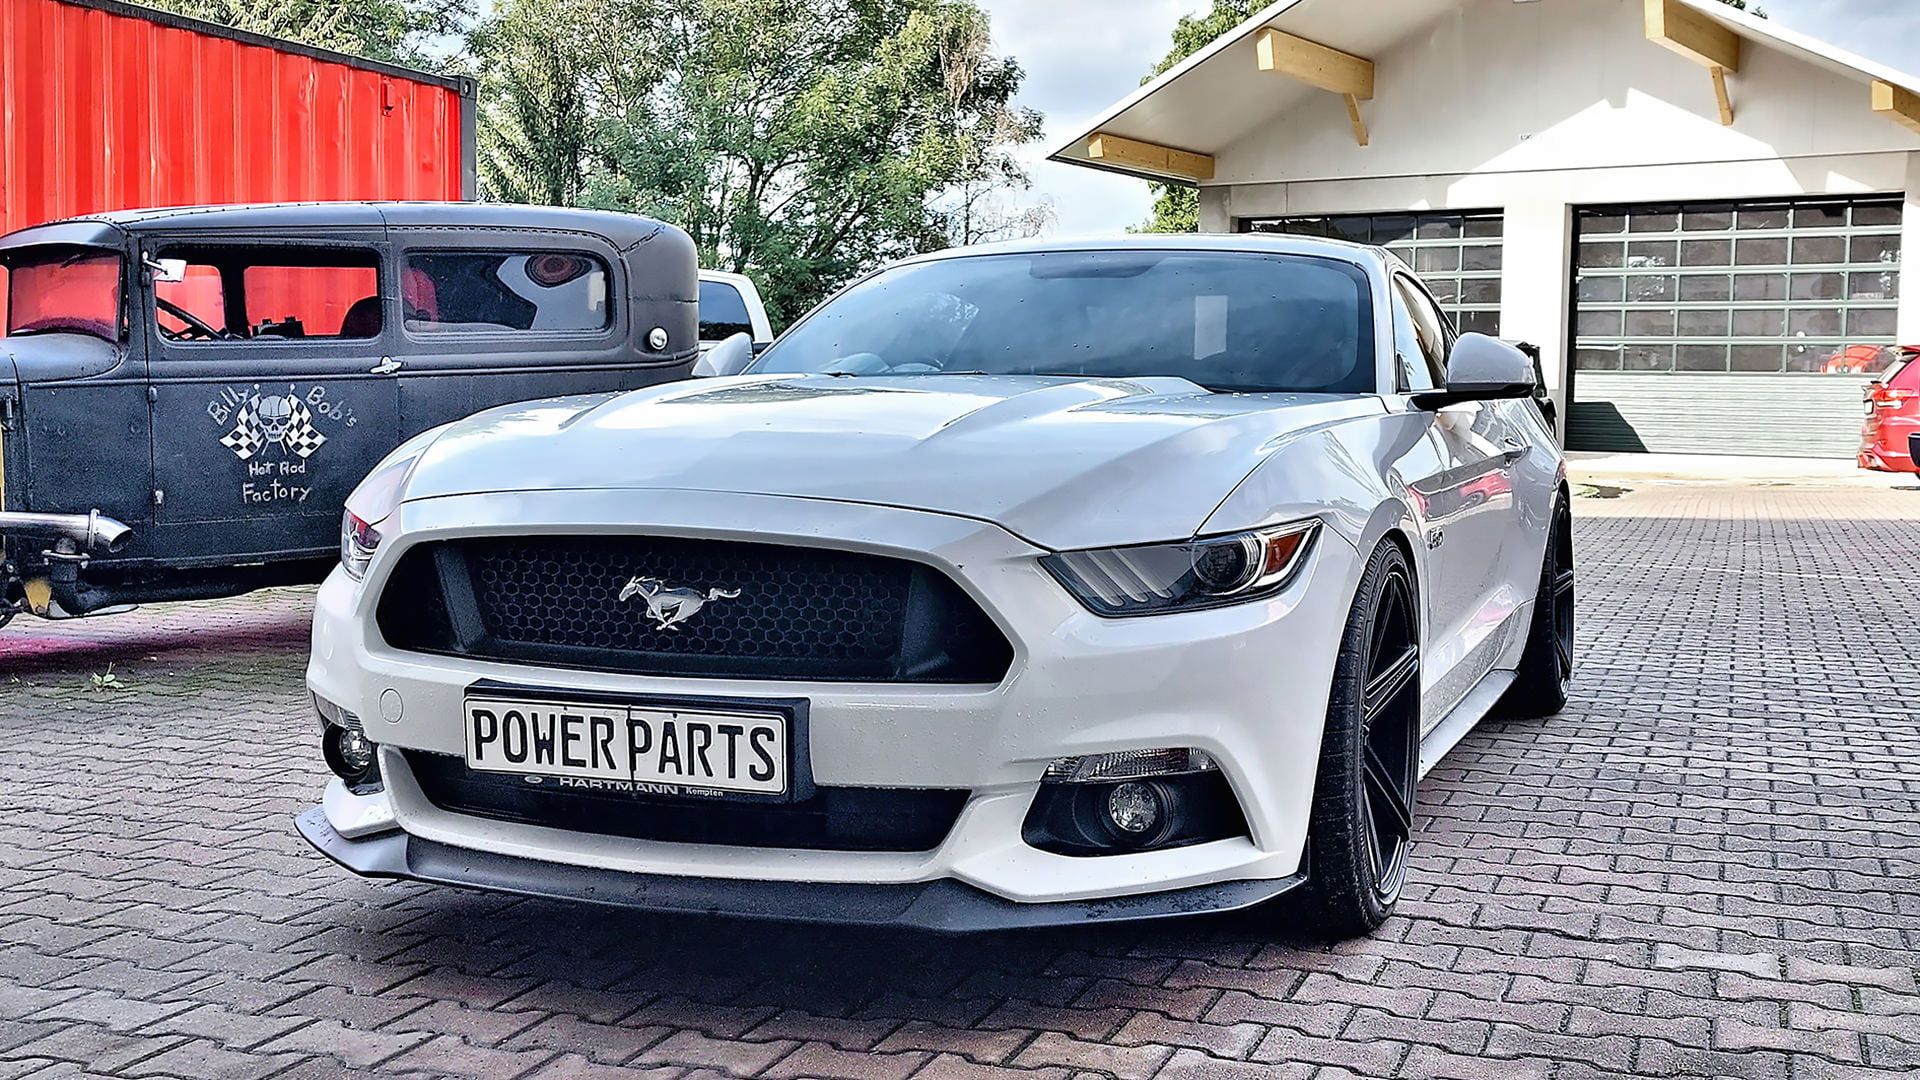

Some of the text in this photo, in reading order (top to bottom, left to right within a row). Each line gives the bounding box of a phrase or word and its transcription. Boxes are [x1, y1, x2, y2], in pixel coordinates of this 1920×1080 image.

[207, 386, 357, 427] Billy Bob's
[249, 459, 306, 477] Hot Rod
[242, 478, 312, 504] Factory
[472, 709, 776, 782] POWER PARTS
[559, 777, 679, 795] HARTMANN
[685, 786, 724, 797] Kempten
